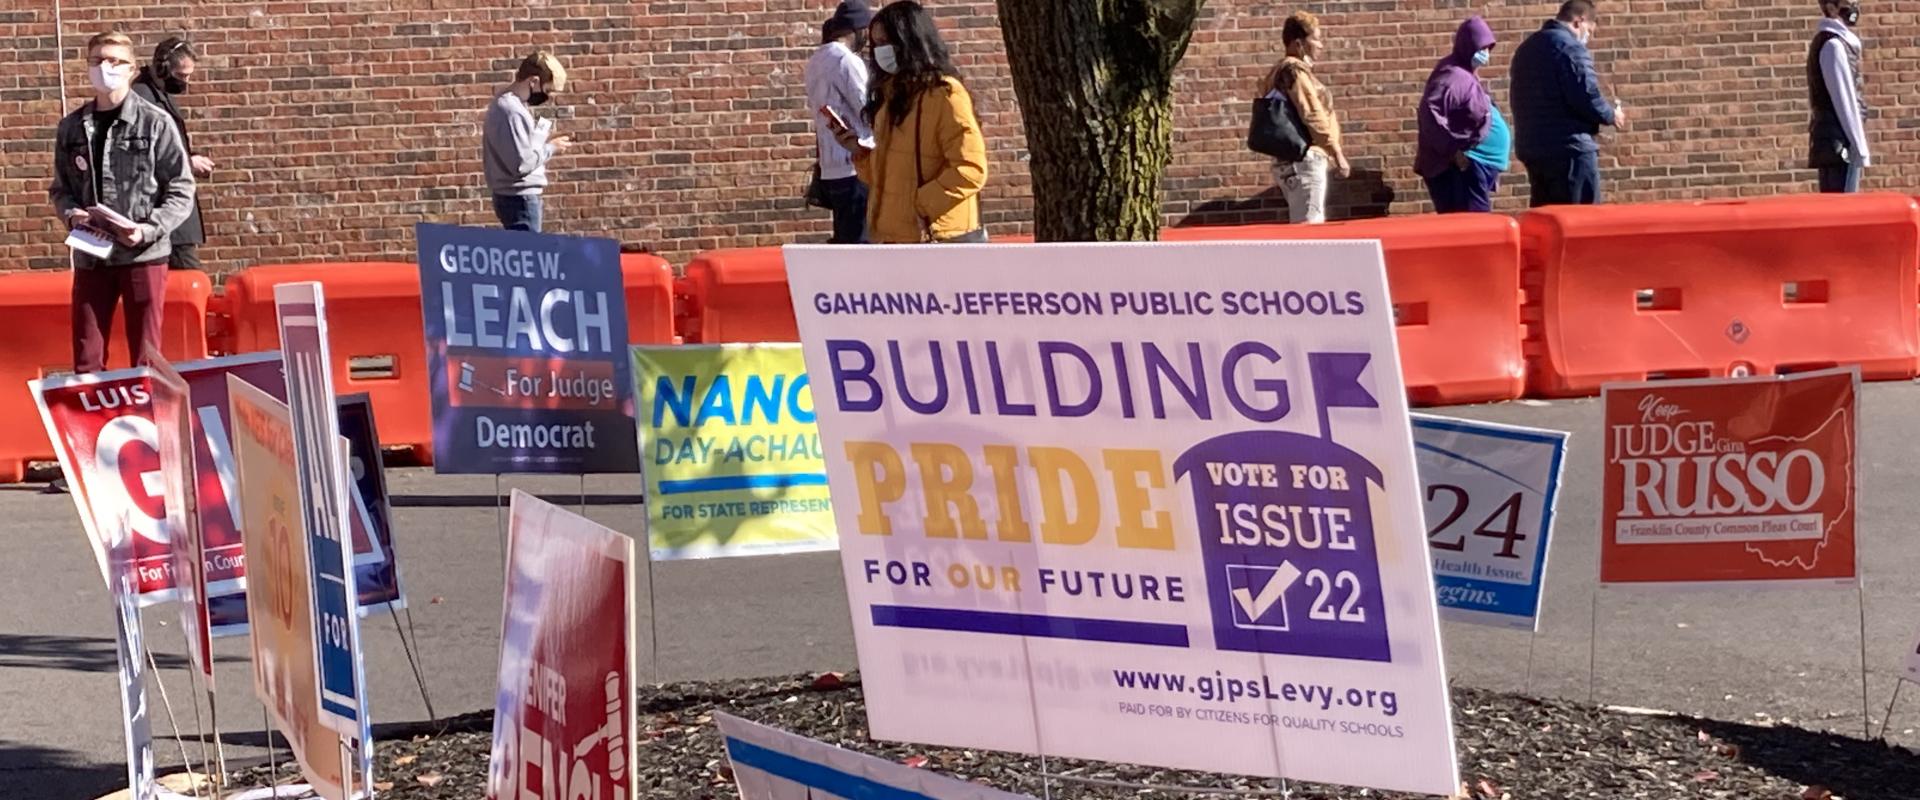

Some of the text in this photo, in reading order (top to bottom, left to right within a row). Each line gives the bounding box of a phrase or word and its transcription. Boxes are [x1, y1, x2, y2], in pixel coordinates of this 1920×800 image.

[440, 244, 566, 280] GEORGE W.
[442, 281, 611, 352] LEACH
[814, 291, 1364, 315] GAHANNA-JEFFERSON PUBLIC SCHOOLS
[79, 384, 150, 411] LUIS
[507, 369, 613, 405] For Judge
[825, 340, 1291, 422] BUILDING
[653, 373, 818, 428] NANC
[476, 416, 595, 448] Democrat
[655, 434, 824, 465] DAY-ACHAU
[1610, 421, 1716, 463] JUDGE
[1206, 462, 1349, 490] VOTE FOR
[1617, 449, 1825, 517] RUSSO
[663, 498, 830, 520] FOR STATE REPRESEN
[845, 441, 1175, 551] PRIDE
[1215, 503, 1356, 550] ISSUE
[1427, 484, 1526, 558] 24
[1630, 523, 1672, 536] Franklin
[1675, 523, 1711, 539] County
[1713, 522, 1759, 536] Common
[1761, 520, 1787, 533] Pleas
[1790, 519, 1817, 532] Court
[139, 566, 162, 582] For
[864, 560, 1185, 602] FOR OUR FUTURE
[1435, 558, 1480, 574] Health
[1305, 569, 1365, 622] 22
[1438, 582, 1499, 606] egins.
[1113, 669, 1398, 716] www.gjpsLevy.org
[1119, 702, 1404, 738] PAID FOR BY CITIZENS FOR QUALITY SCHOOLS
